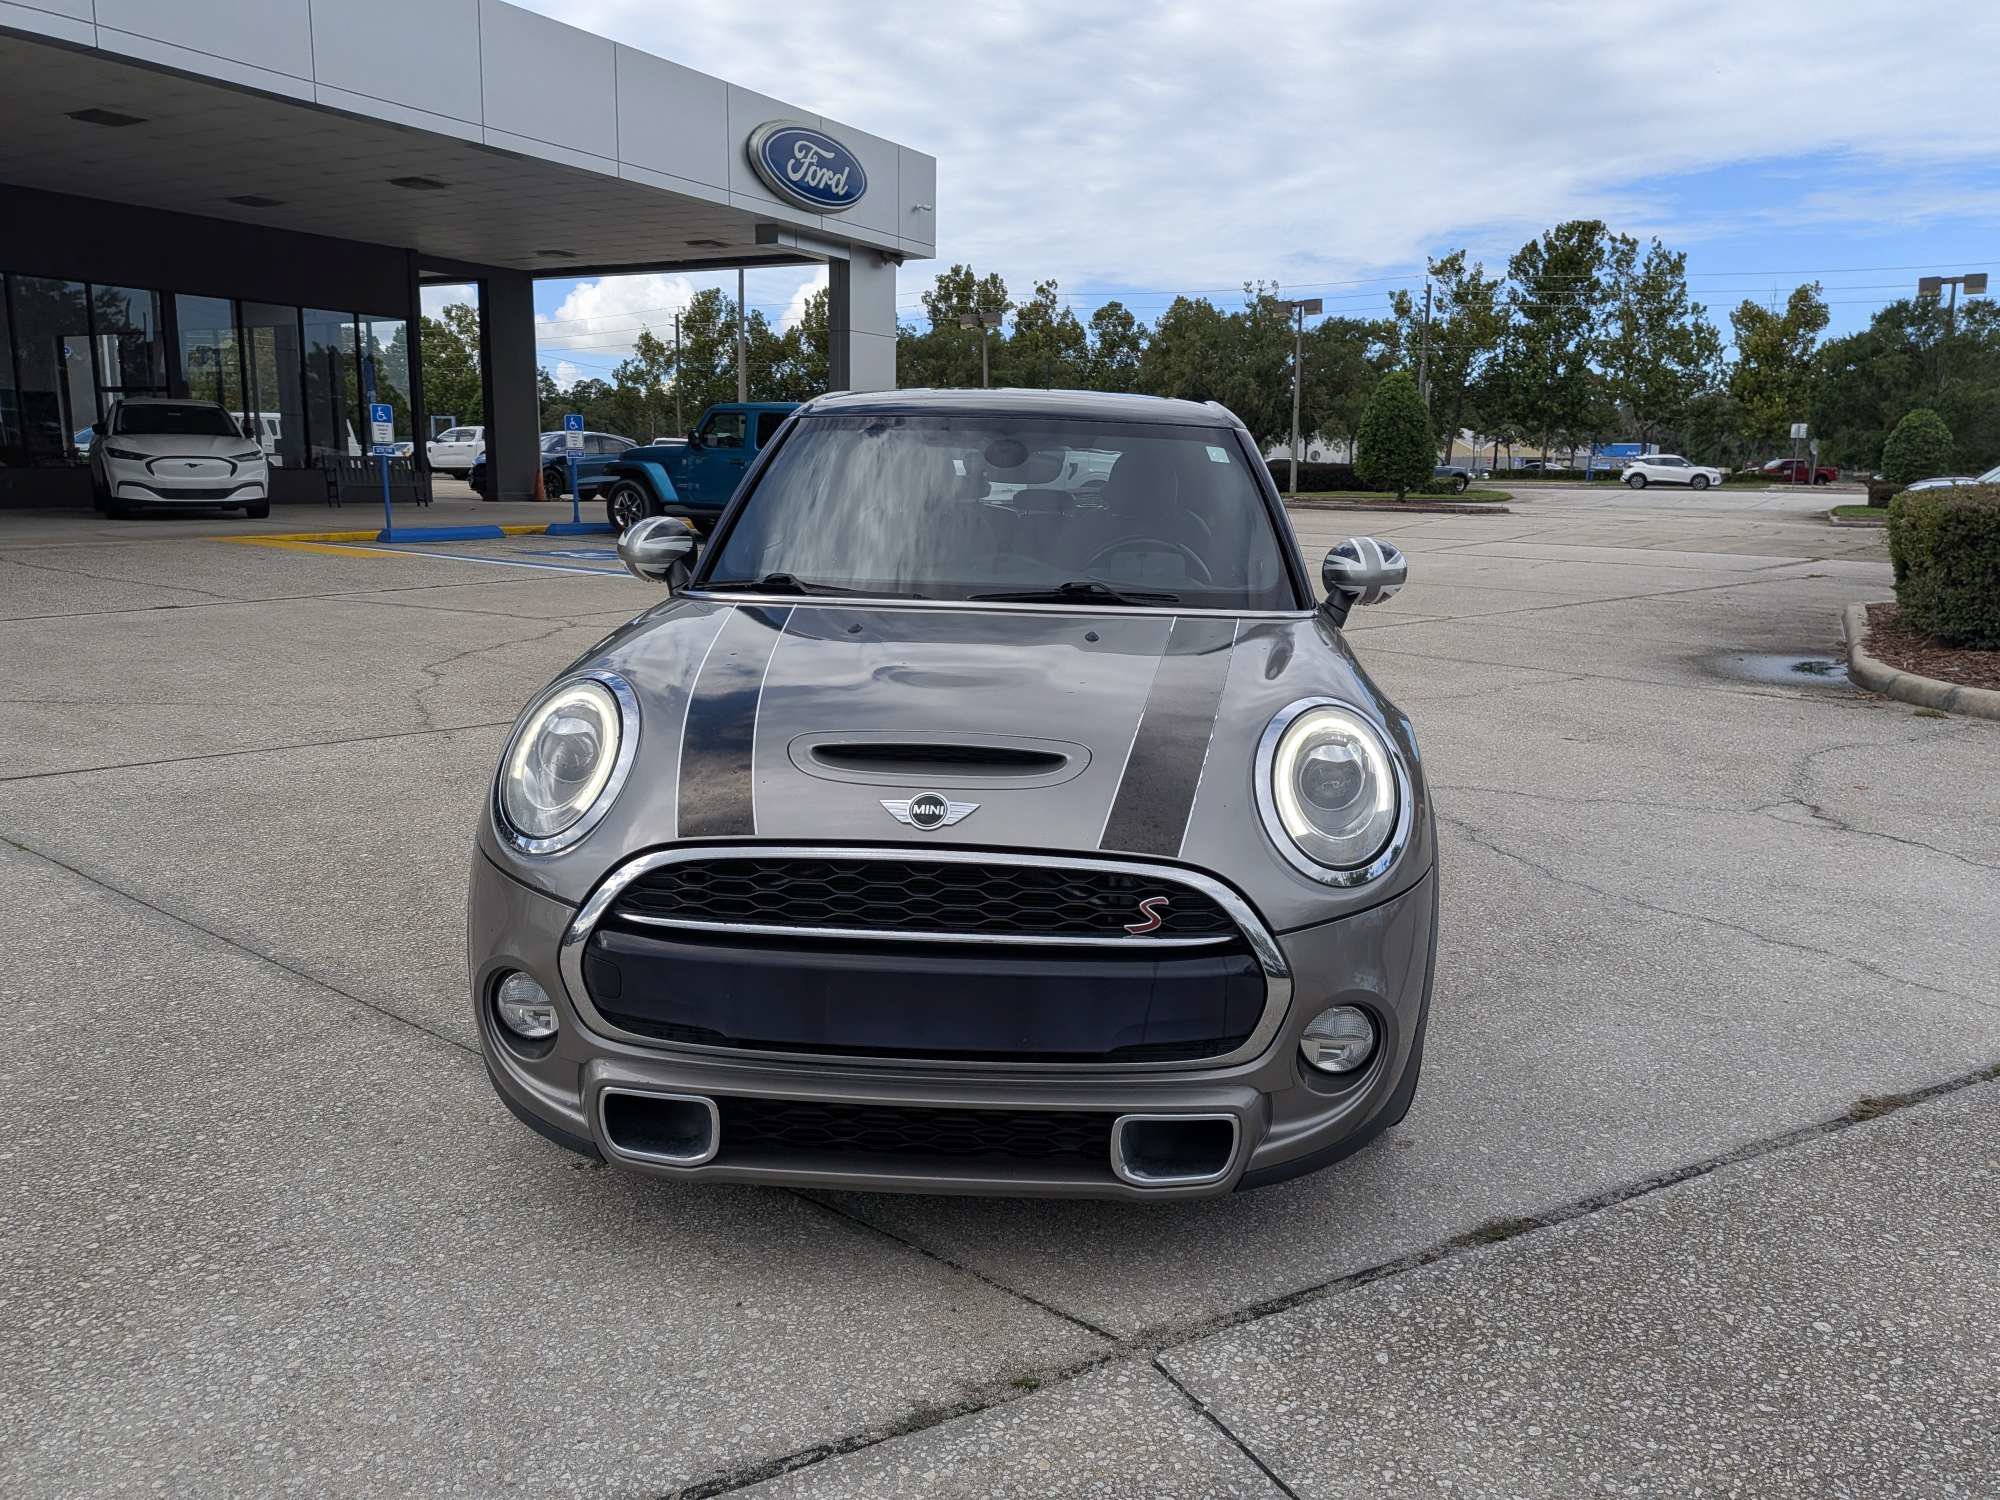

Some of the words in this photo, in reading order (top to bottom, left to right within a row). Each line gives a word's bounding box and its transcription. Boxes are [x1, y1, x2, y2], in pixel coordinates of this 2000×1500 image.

[787, 140, 850, 196] Ford
[912, 804, 945, 816] MINI
[1123, 896, 1169, 935] S
